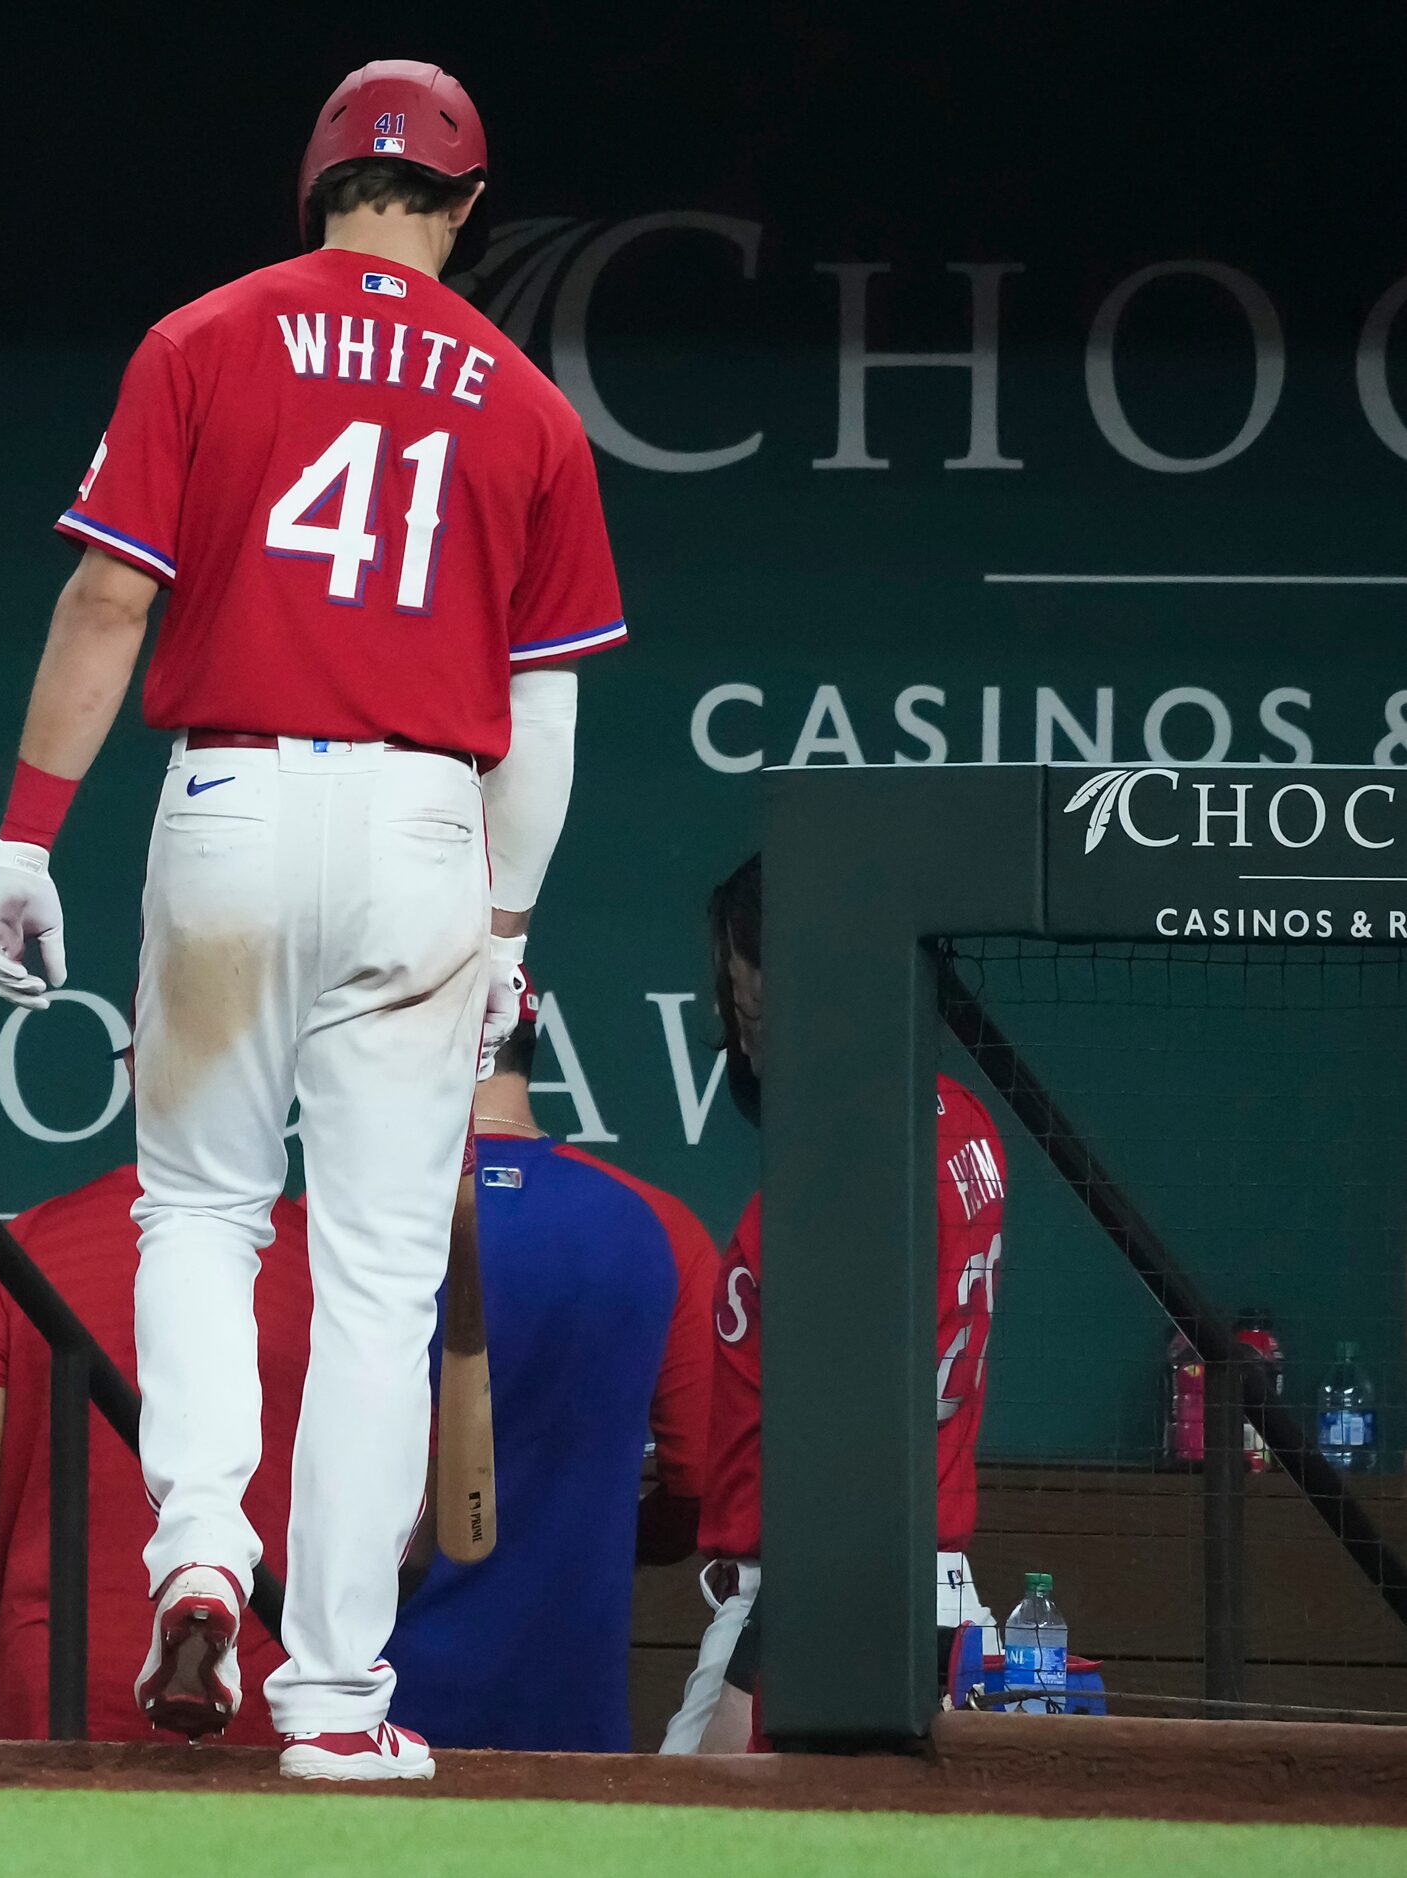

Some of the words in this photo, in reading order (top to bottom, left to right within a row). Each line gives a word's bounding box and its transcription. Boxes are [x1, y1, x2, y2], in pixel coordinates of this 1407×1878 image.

[373, 112, 406, 136] 41
[277, 313, 498, 408] WHITE
[264, 420, 455, 613] 41
[690, 682, 1314, 773] CASINOS
[1118, 767, 1395, 849] CHOC
[1155, 907, 1334, 937] CASINOS
[1350, 910, 1373, 938] &
